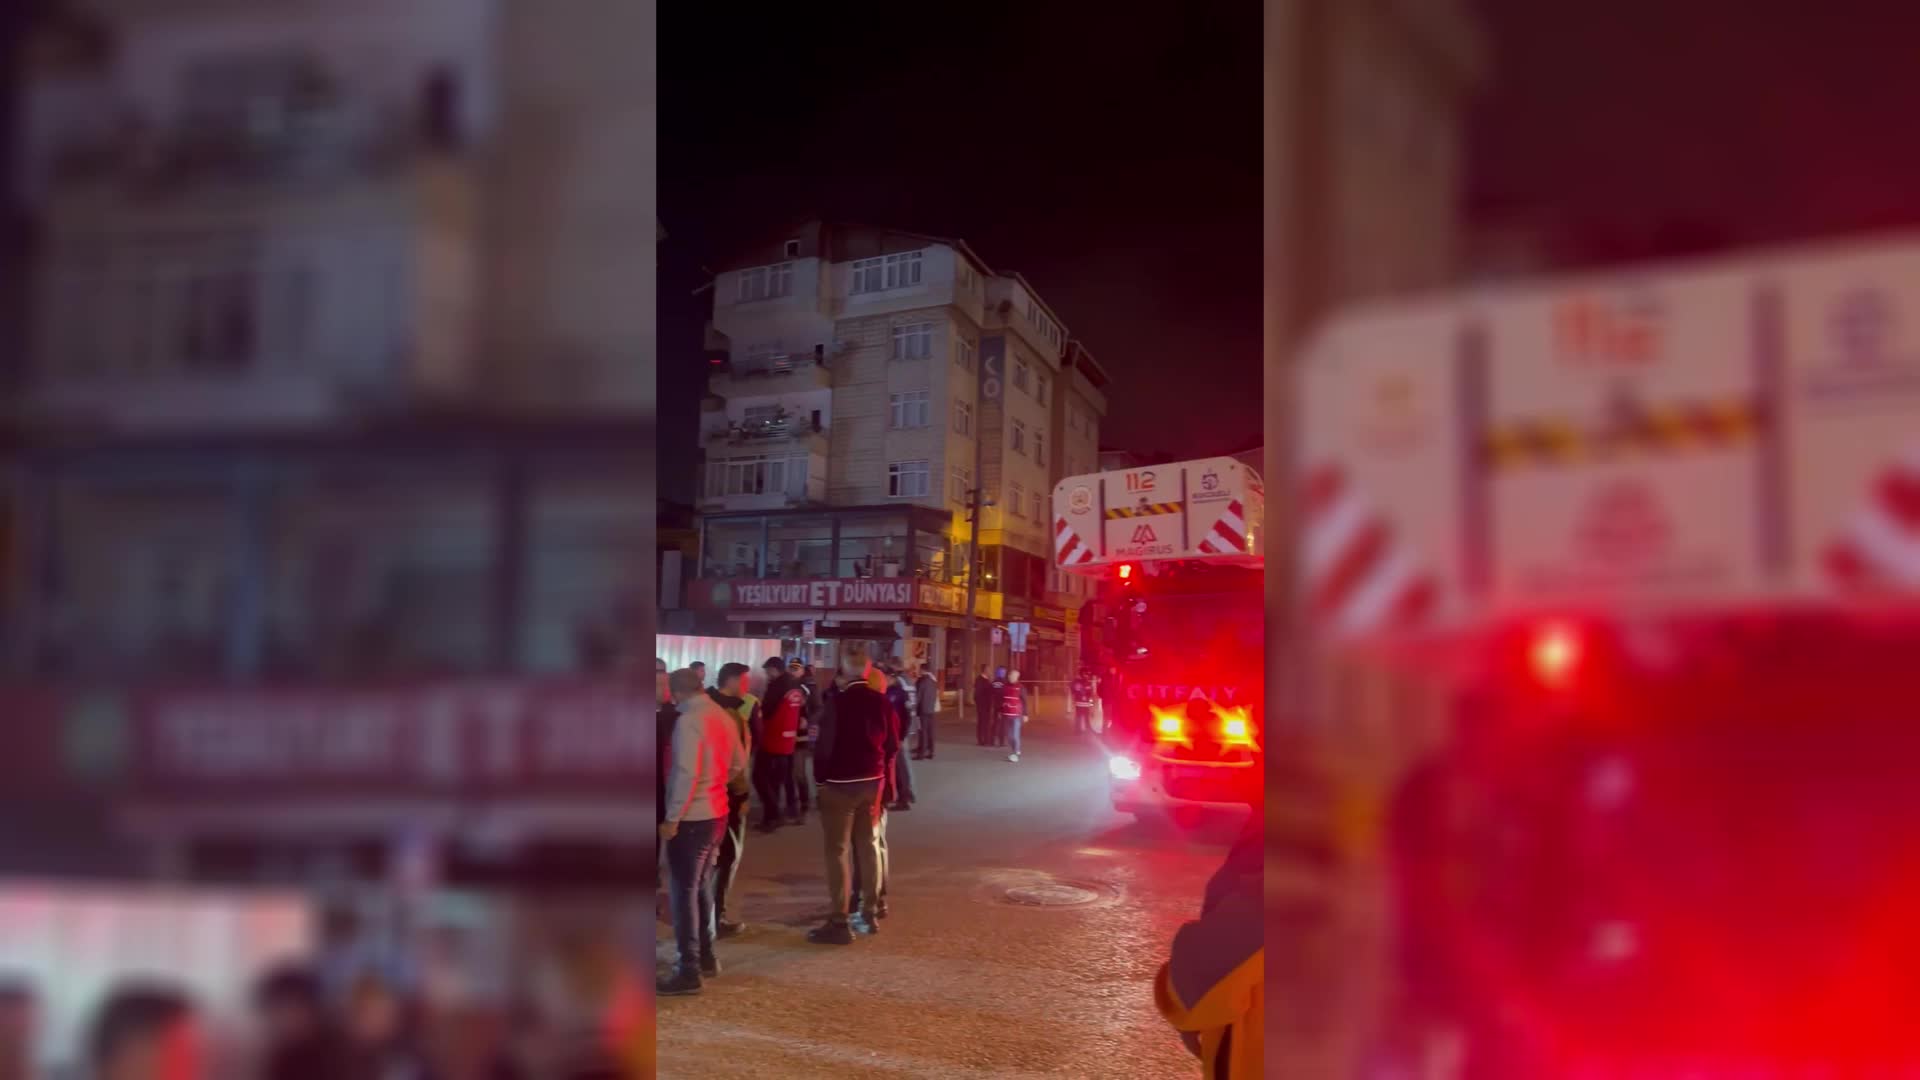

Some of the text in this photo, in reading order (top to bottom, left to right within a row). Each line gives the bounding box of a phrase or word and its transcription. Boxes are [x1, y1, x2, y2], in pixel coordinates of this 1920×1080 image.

[1126, 471, 1155, 491] 112
[810, 581, 842, 606] ET
[843, 579, 911, 603] DÜNYASI
